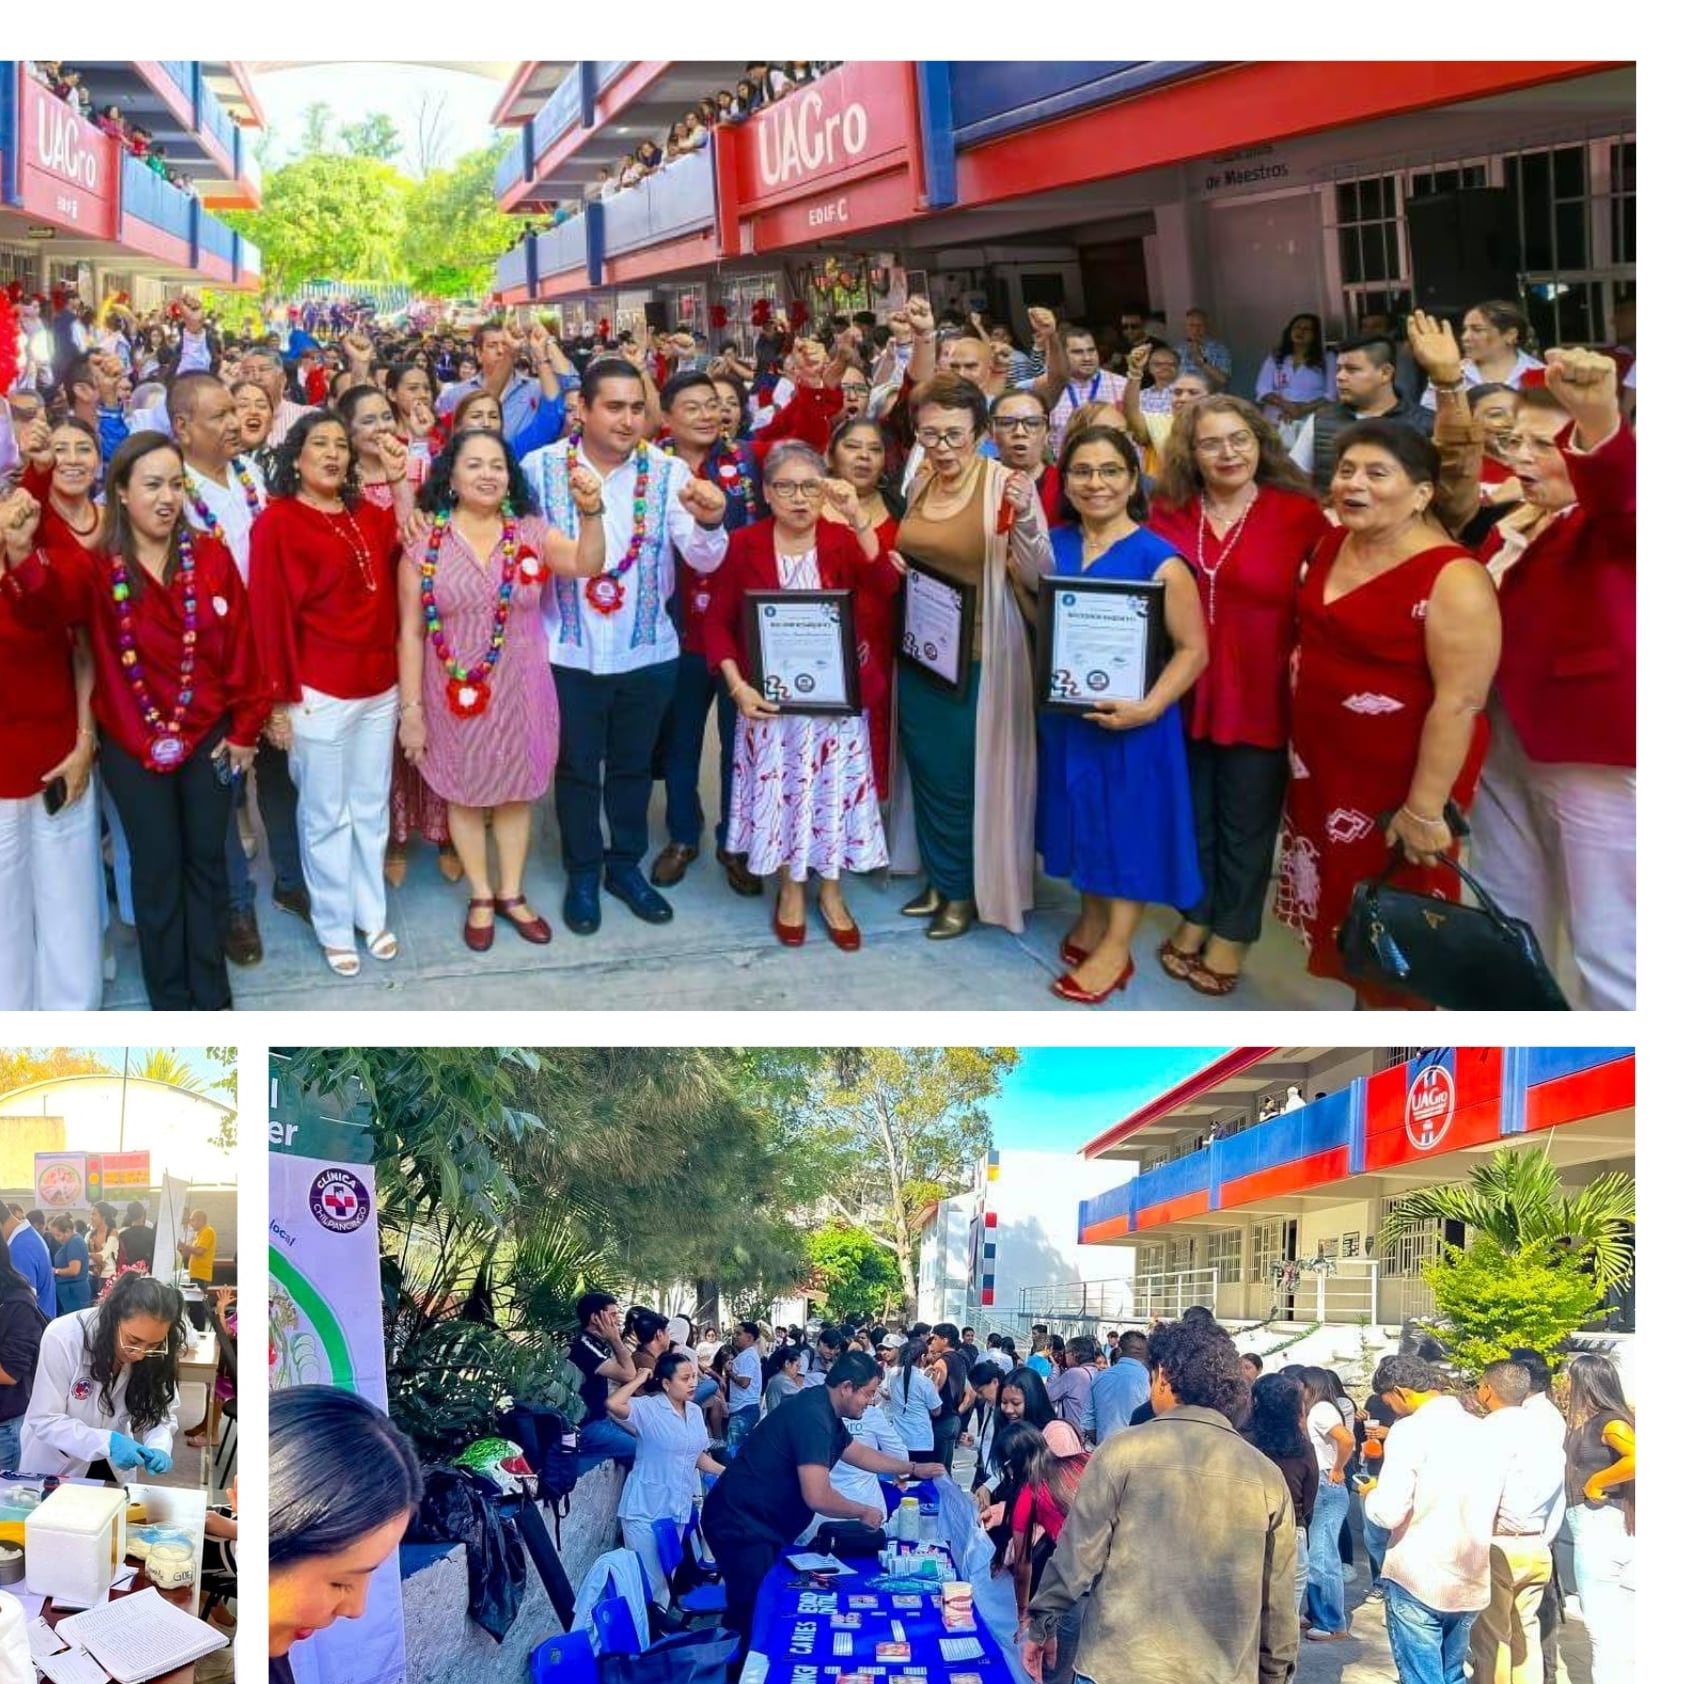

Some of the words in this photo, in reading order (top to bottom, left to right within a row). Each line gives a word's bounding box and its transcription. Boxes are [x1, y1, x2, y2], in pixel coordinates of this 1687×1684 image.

[758, 91, 867, 186] UAGro
[1225, 162, 1289, 187] Maestros
[1412, 1084, 1449, 1110] UAGro
[316, 1168, 357, 1190] CLÍNICA
[313, 1202, 367, 1233] CHILPANCINGO
[789, 1621, 817, 1654] CARIES
